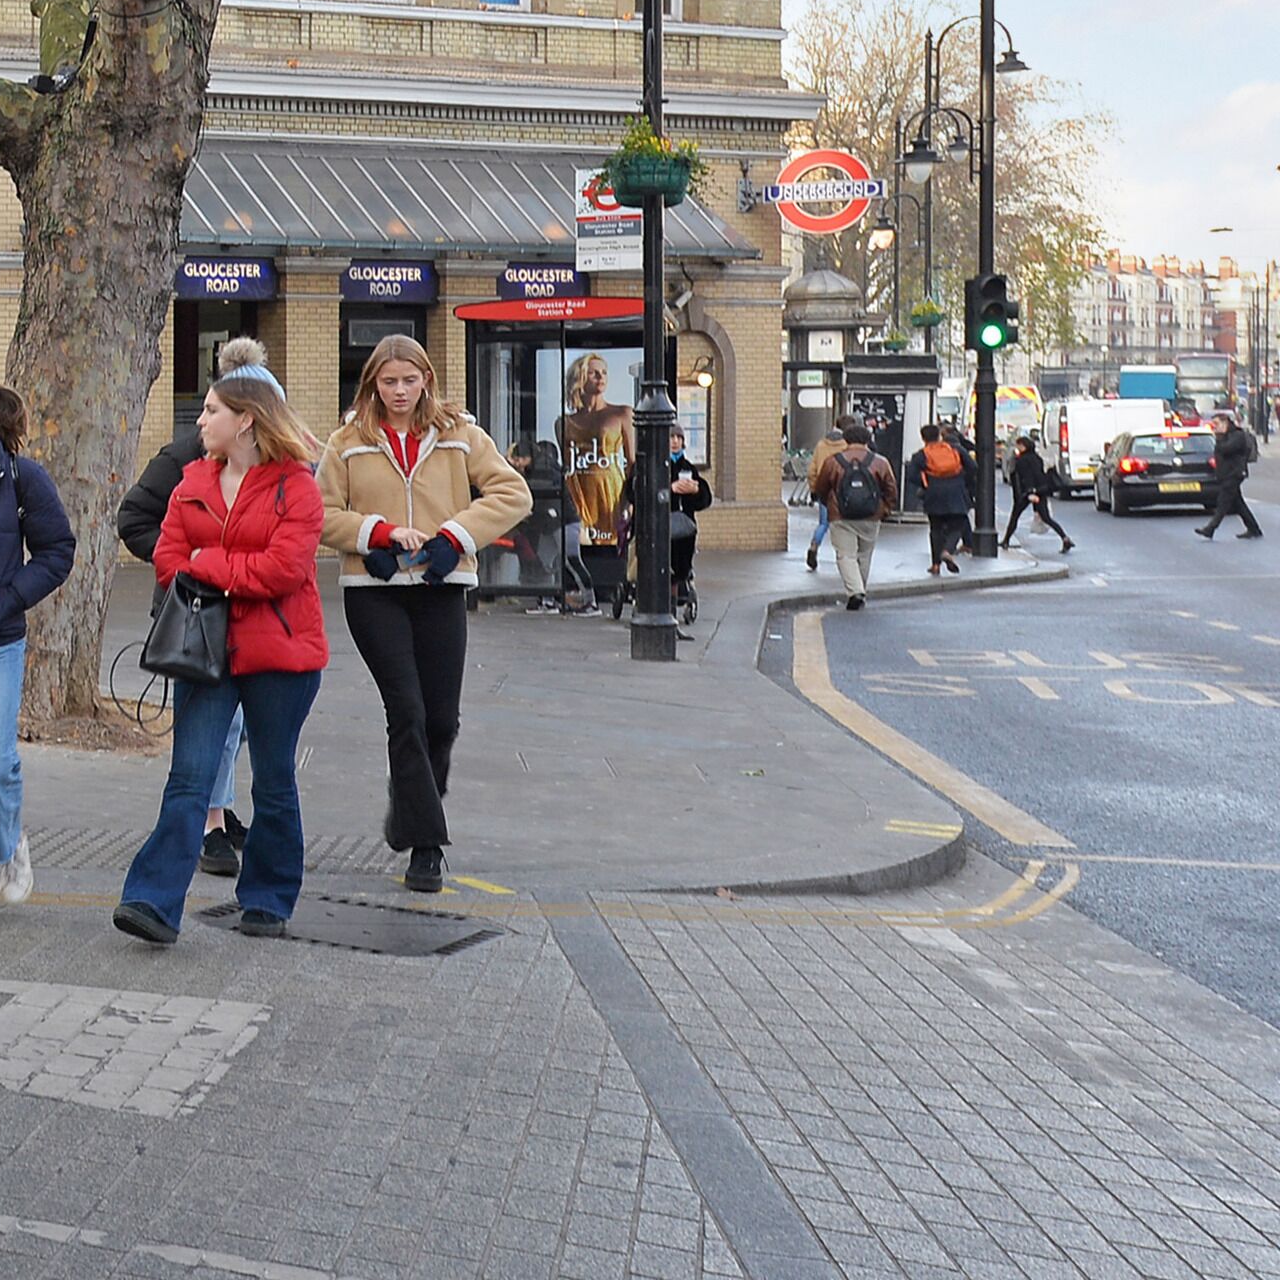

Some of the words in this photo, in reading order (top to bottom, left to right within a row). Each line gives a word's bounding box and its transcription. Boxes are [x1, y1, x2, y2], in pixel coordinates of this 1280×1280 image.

[767, 180, 880, 201] UNDERGROUND
[184, 263, 261, 278] GLOUCESTER
[349, 266, 422, 282] GLOUCESTER
[505, 268, 574, 283] GLOUCESTER
[206, 279, 239, 293] ROAD
[369, 282, 402, 296] ROAD
[524, 283, 555, 297] ROAD
[525, 300, 566, 310] Gloucester
[567, 299, 586, 308] Road
[538, 308, 564, 317] Station
[585, 526, 613, 541] Dior
[907, 648, 1244, 673] BUS
